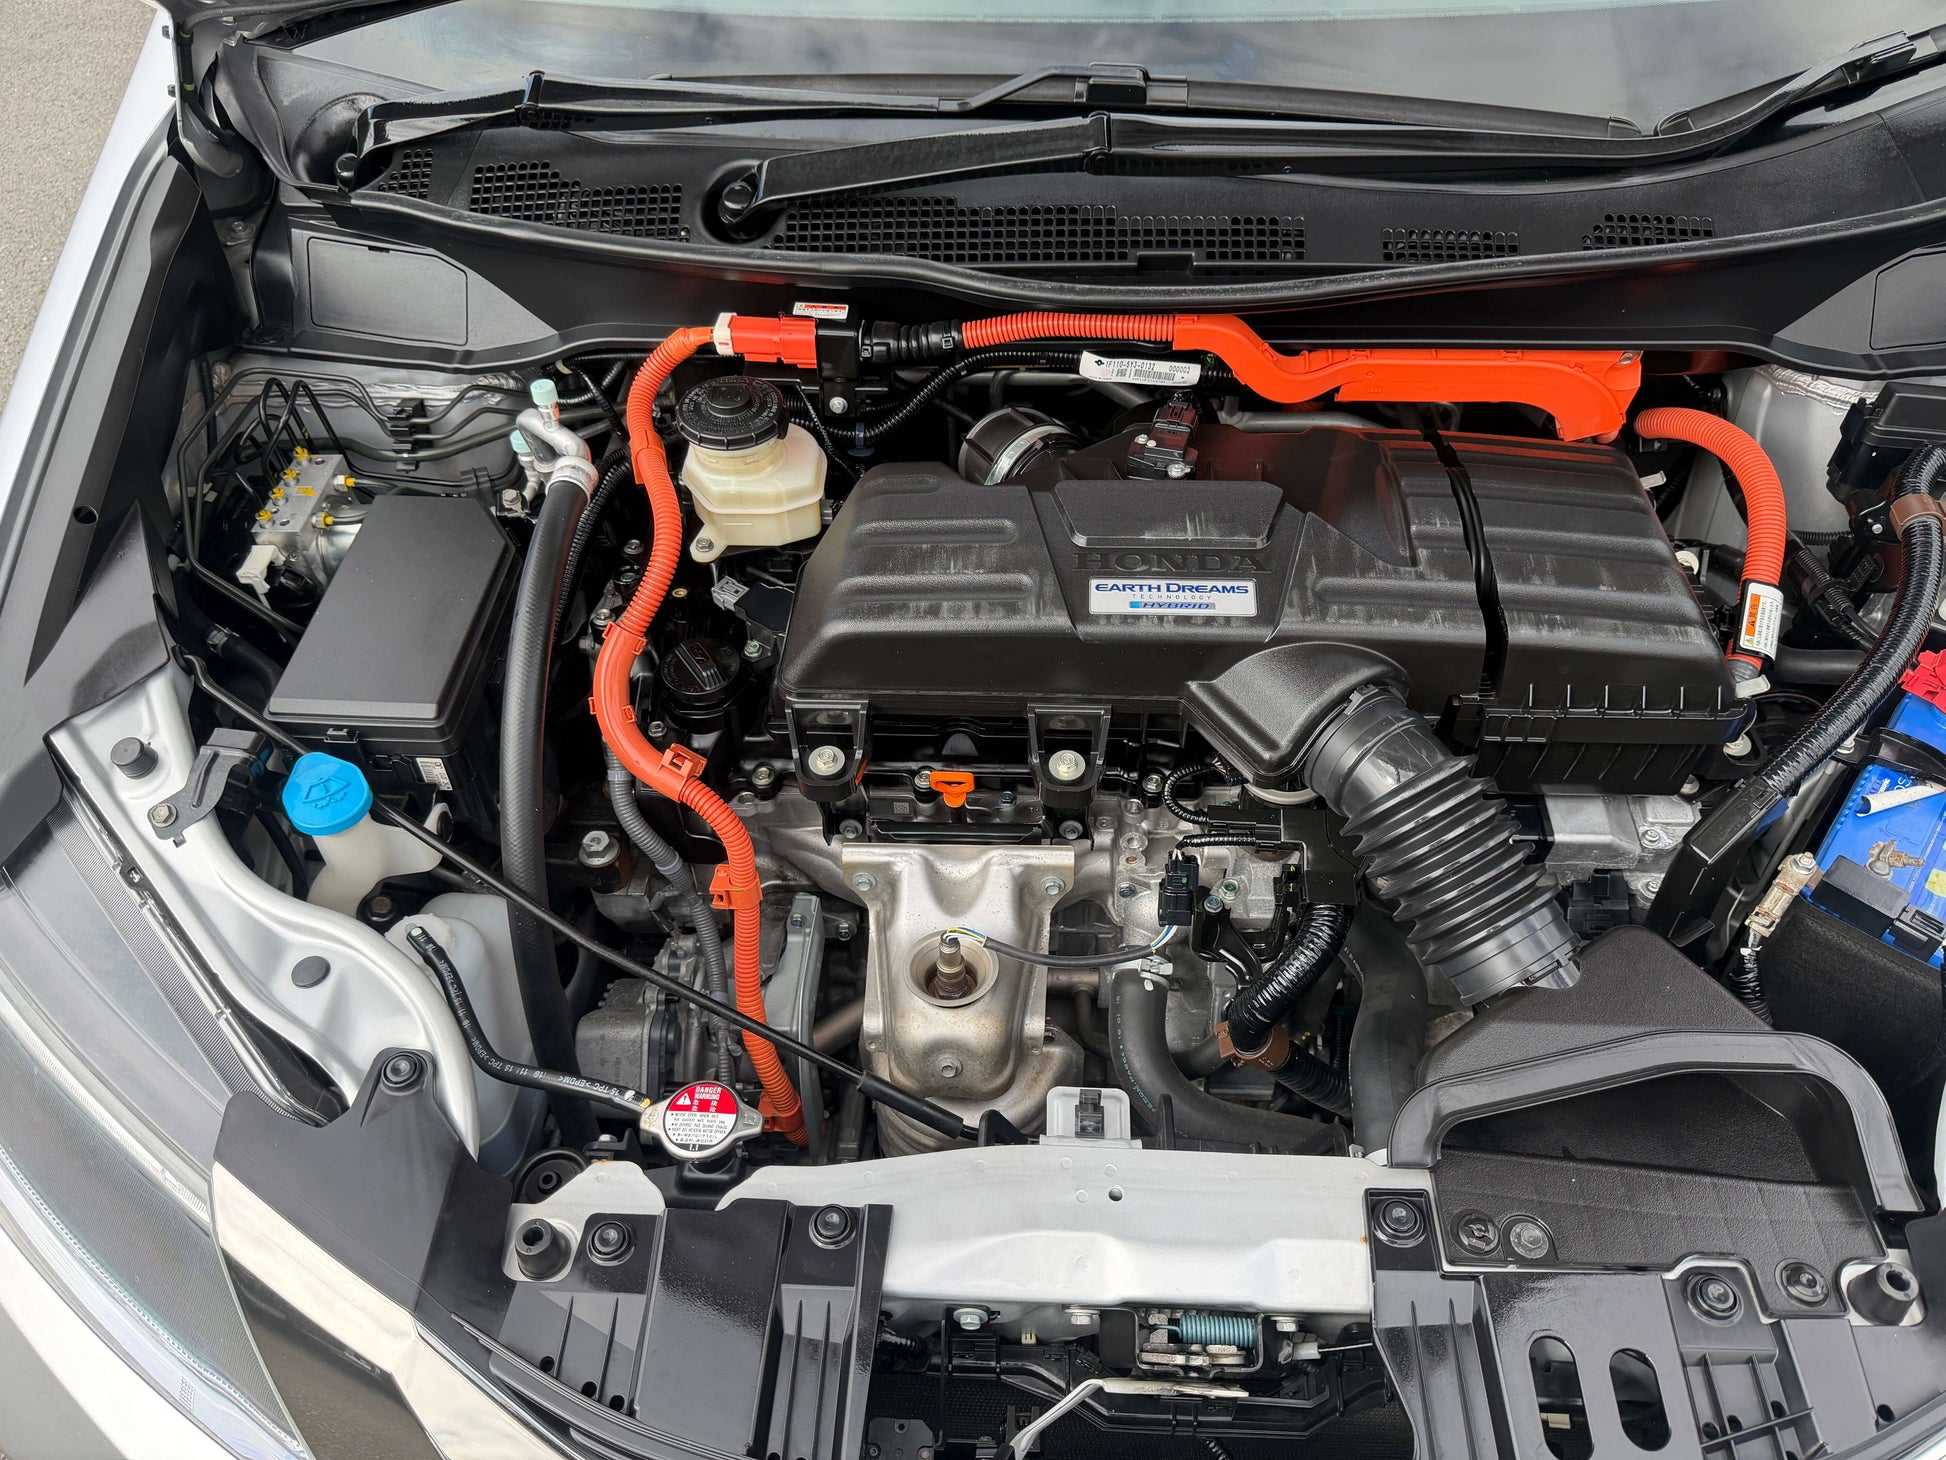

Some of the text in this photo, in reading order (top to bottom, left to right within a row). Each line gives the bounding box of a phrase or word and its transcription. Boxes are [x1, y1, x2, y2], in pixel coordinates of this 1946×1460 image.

[1168, 365, 1191, 374] 000002
[1073, 552, 1272, 574] HONDA
[1094, 583, 1161, 593] EARTH
[1131, 593, 1213, 601] TECHNOLOGY
[1142, 601, 1210, 610] HYBRID
[470, 1036, 489, 1061] >EPDM<
[488, 1057, 503, 1070] TPC
[504, 1064, 514, 1073] 15
[592, 1083, 609, 1094] TPC
[695, 1086, 722, 1094] DANGER
